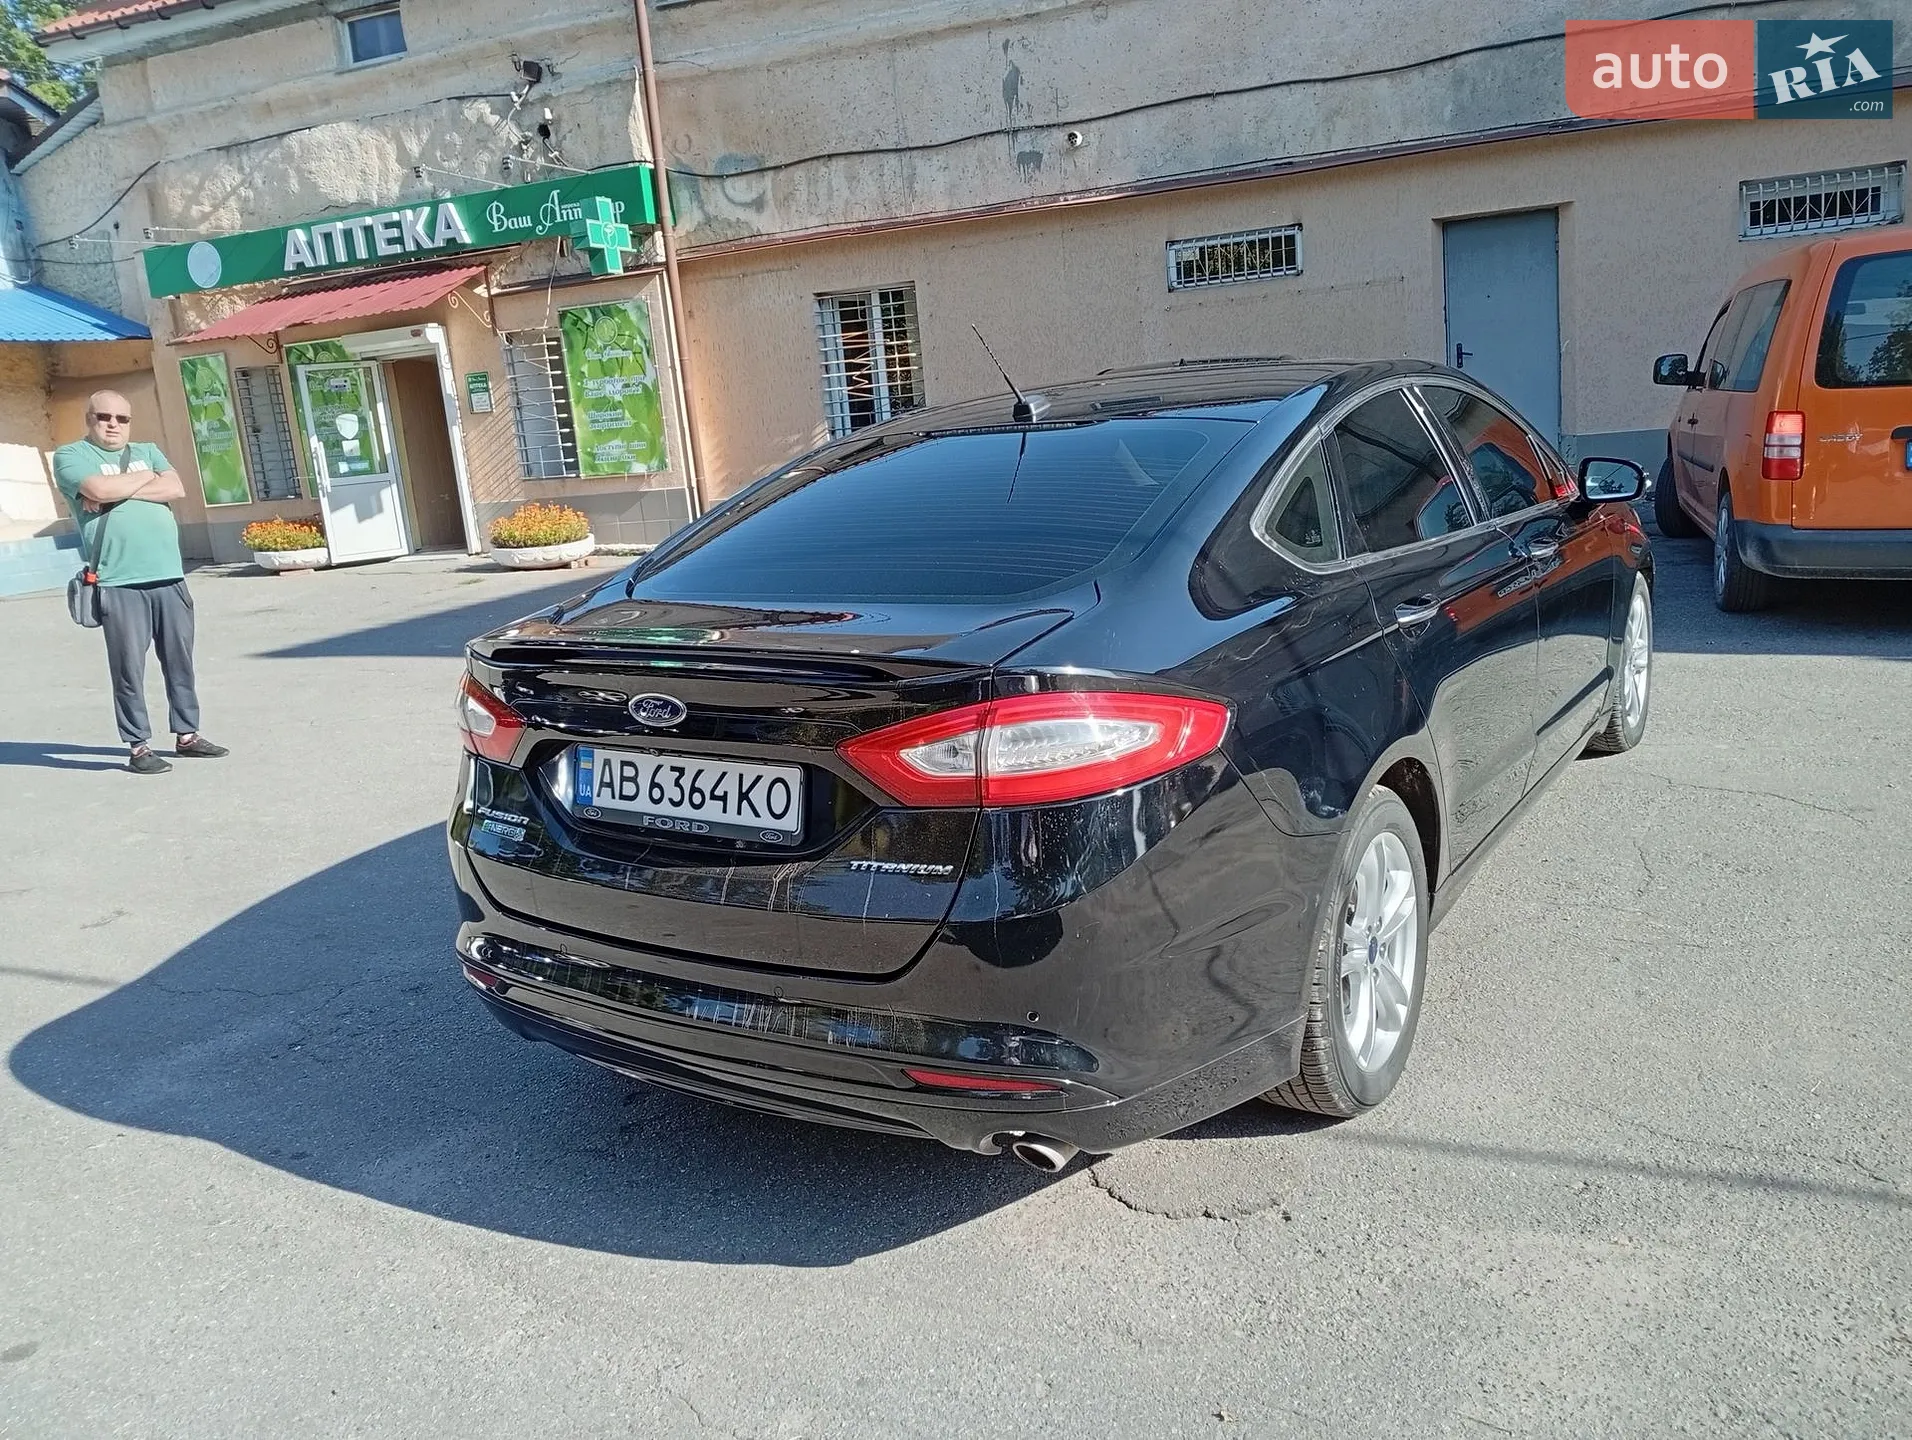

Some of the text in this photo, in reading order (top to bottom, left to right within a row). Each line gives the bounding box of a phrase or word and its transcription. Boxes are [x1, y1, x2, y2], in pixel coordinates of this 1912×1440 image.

[486, 200, 532, 233] Ваш
[284, 203, 471, 271] АПТЕКА
[638, 698, 672, 719] Ford
[579, 783, 592, 798] UA
[597, 758, 792, 821] AB 6364 KO
[477, 806, 530, 825] FUSION
[642, 815, 710, 834] FORD
[850, 861, 954, 875] TITANIUM
